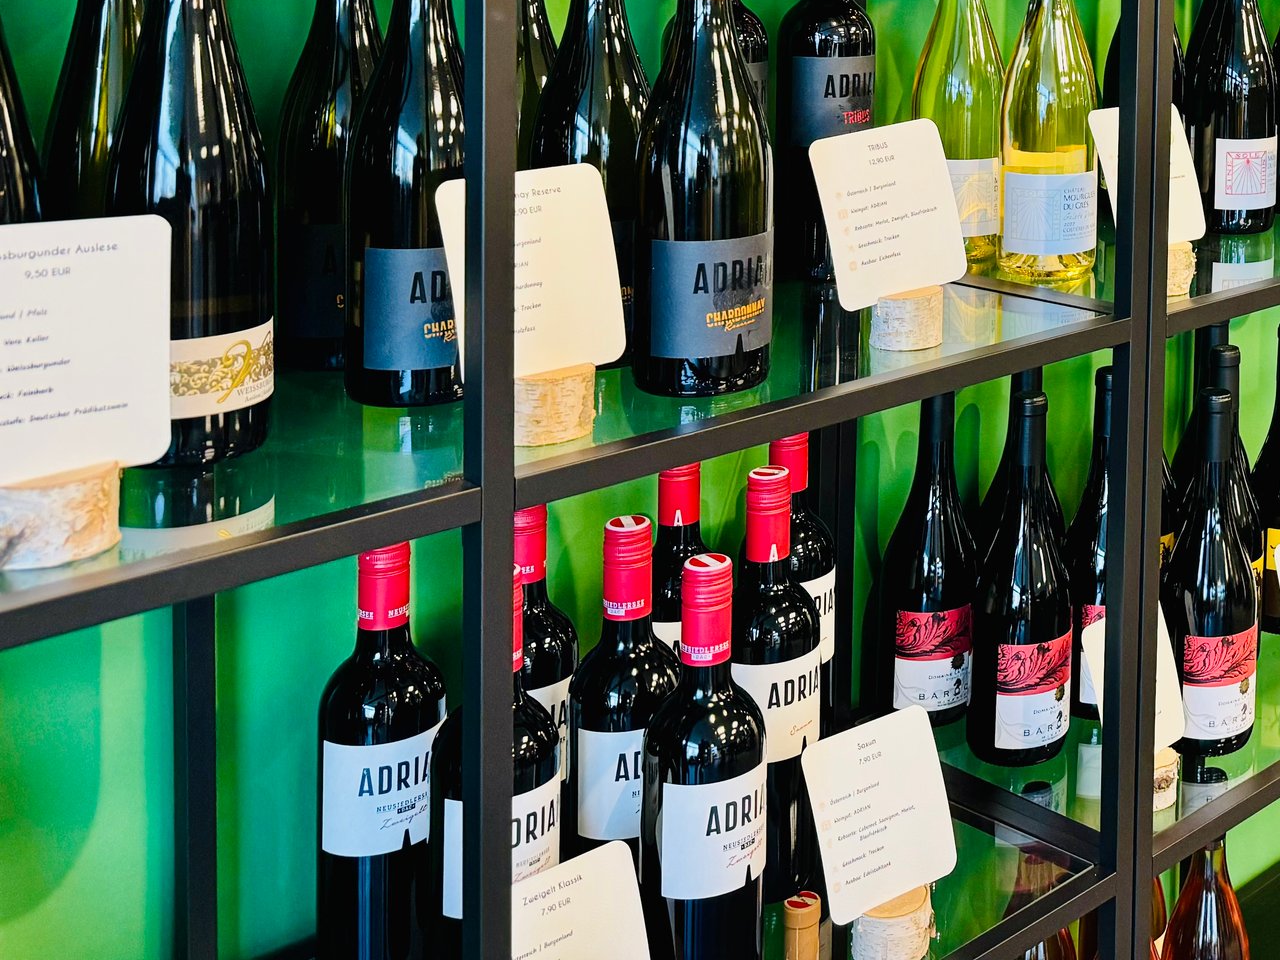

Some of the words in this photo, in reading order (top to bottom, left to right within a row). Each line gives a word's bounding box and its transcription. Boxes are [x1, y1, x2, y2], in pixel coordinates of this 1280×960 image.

[843, 109, 870, 125] TRIBUS
[868, 142, 889, 151] TRIBUS
[885, 154, 895, 163] EUR
[532, 186, 562, 196] Reserve
[529, 205, 542, 214] EUR
[0, 246, 71, 261] sburgunder
[75, 242, 118, 254] Auslese
[24, 268, 48, 280] 9,50
[51, 266, 71, 277] EUR
[515, 280, 543, 291] hardonnay
[521, 302, 542, 312] Trocken
[705, 296, 766, 328] CHARDONNAY
[767, 665, 820, 710] ADRIA
[857, 738, 877, 751] Saxum
[859, 754, 871, 765] 7,90
[872, 751, 883, 761] EUR
[358, 751, 430, 797] ADRIA
[706, 783, 764, 837] ADRIA
[512, 794, 559, 849] DRIA
[868, 844, 885, 856] Trocken
[523, 883, 556, 906] Zweigelt
[558, 874, 584, 888] Klassik
[541, 905, 557, 917] 7,90
[558, 898, 572, 909] EUR
[543, 930, 574, 949] Burgenland
